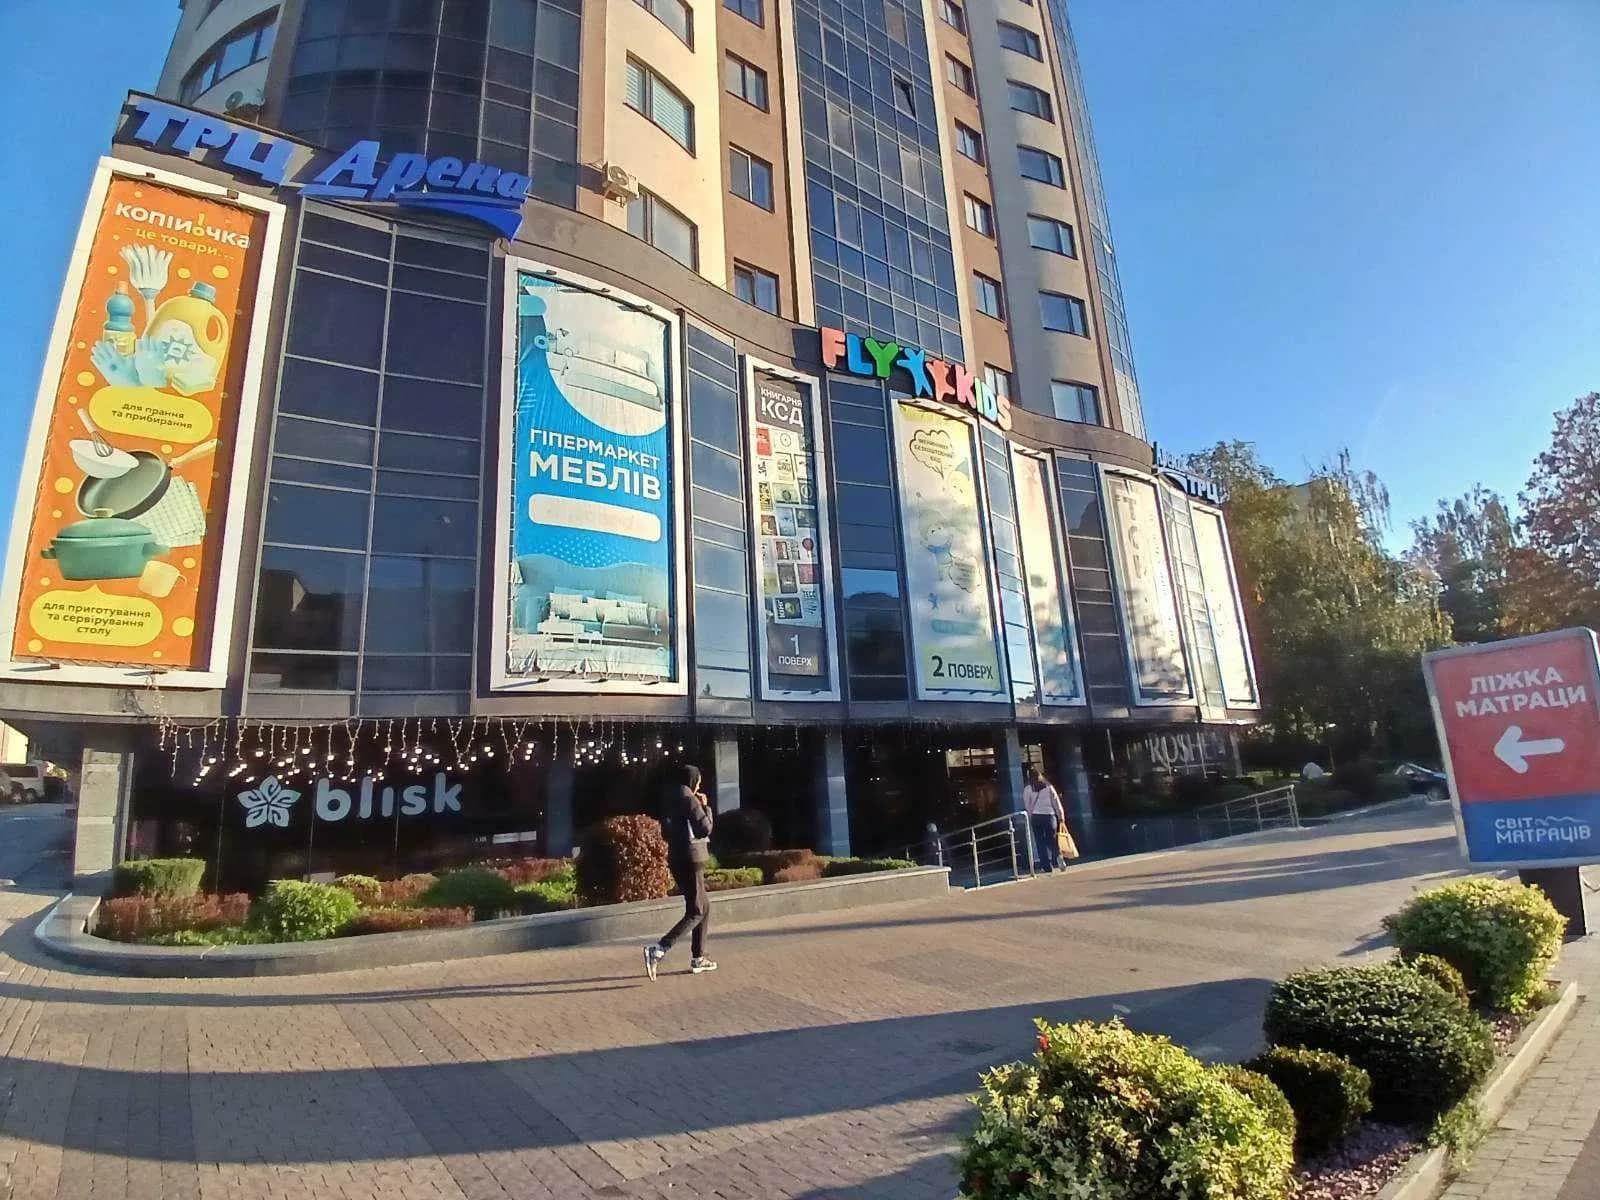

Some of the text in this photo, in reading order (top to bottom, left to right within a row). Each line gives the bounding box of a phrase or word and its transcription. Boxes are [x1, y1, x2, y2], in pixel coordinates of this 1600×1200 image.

[135, 99, 532, 199] ТРЦ Арена
[136, 228, 157, 241] це
[820, 326, 1011, 431] FLY KIDS
[760, 387, 803, 407] КНИГАРНЯ
[121, 403, 184, 418] для прання
[125, 412, 193, 429] прибирання
[761, 397, 804, 428] КСД
[530, 428, 660, 470] ГІПЕРМАРКЕТ
[529, 451, 661, 500] МЕБЛІВ
[43, 601, 151, 618] для приготування
[48, 612, 144, 628] та сервірування
[76, 626, 112, 637] столу
[790, 634, 800, 656] 1
[778, 655, 812, 667] ПОВЕРХ
[931, 655, 994, 680] 2 ПОВЕРХ
[1469, 666, 1564, 695] ЛІЖКА
[1455, 685, 1587, 718] МАТРАЦИ
[1494, 817, 1537, 829] СВІТ
[1495, 825, 1592, 845] МАТРАЦІВ
